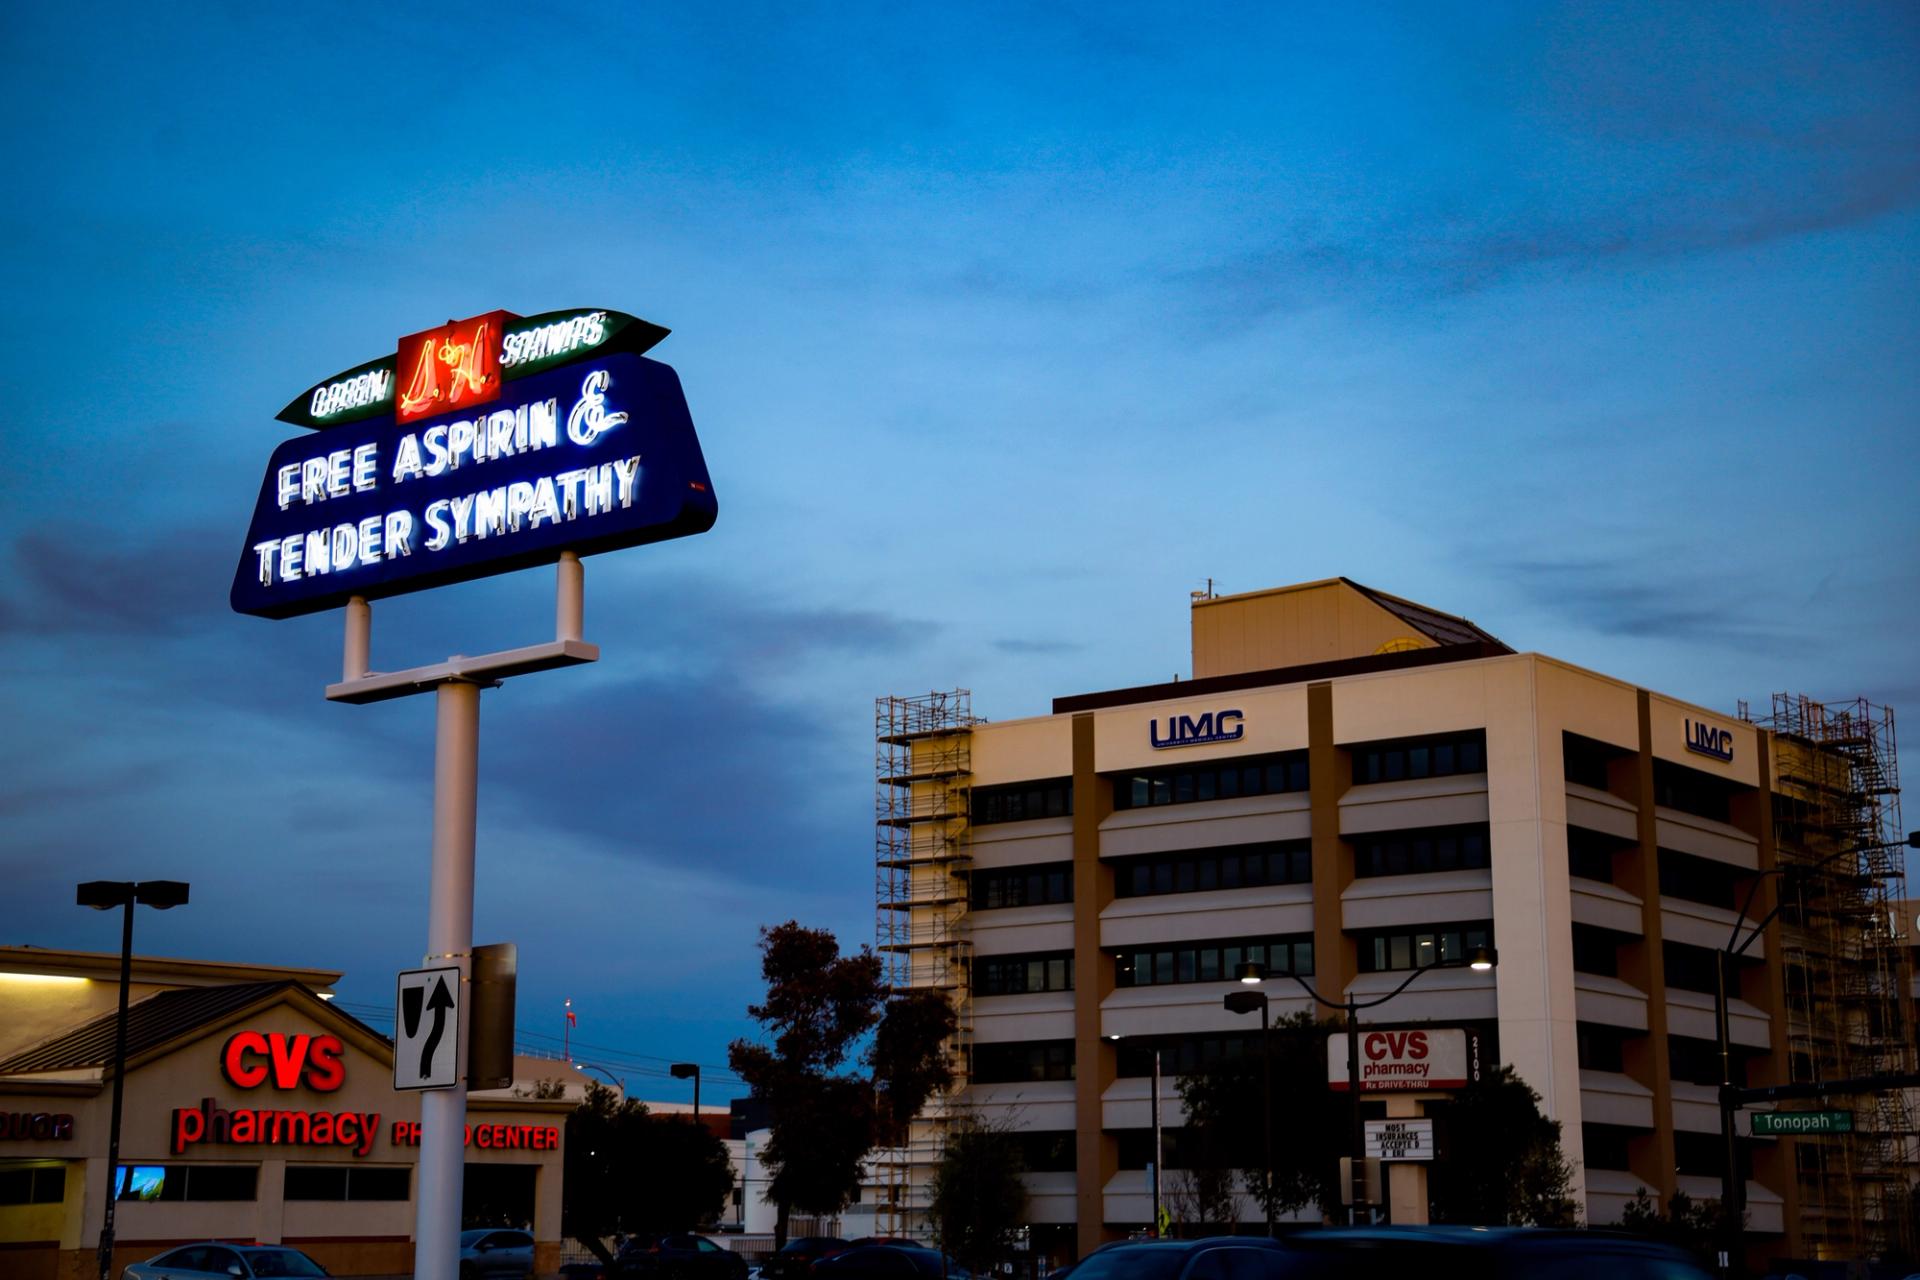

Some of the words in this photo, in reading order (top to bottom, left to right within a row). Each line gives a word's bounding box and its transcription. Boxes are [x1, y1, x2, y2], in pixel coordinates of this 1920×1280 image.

[499, 311, 607, 368] STAMPS
[278, 442, 378, 511] FREE
[393, 397, 557, 484] ASPIRIN
[567, 369, 629, 446] &
[253, 510, 413, 587] TENDER
[425, 455, 641, 551] SYMPATHY
[1149, 709, 1244, 748] UMC
[1685, 718, 1733, 761] UMC
[221, 1031, 346, 1092] CVS
[1364, 1031, 1429, 1060] CVS
[1472, 1036, 1480, 1082] 2100
[1364, 1062, 1430, 1078] pharmacy
[170, 1098, 380, 1157] pharmacy
[474, 1124, 559, 1150] CENTER
[1385, 1123, 1405, 1131] MOST
[1764, 1113, 1830, 1132] Tonopah
